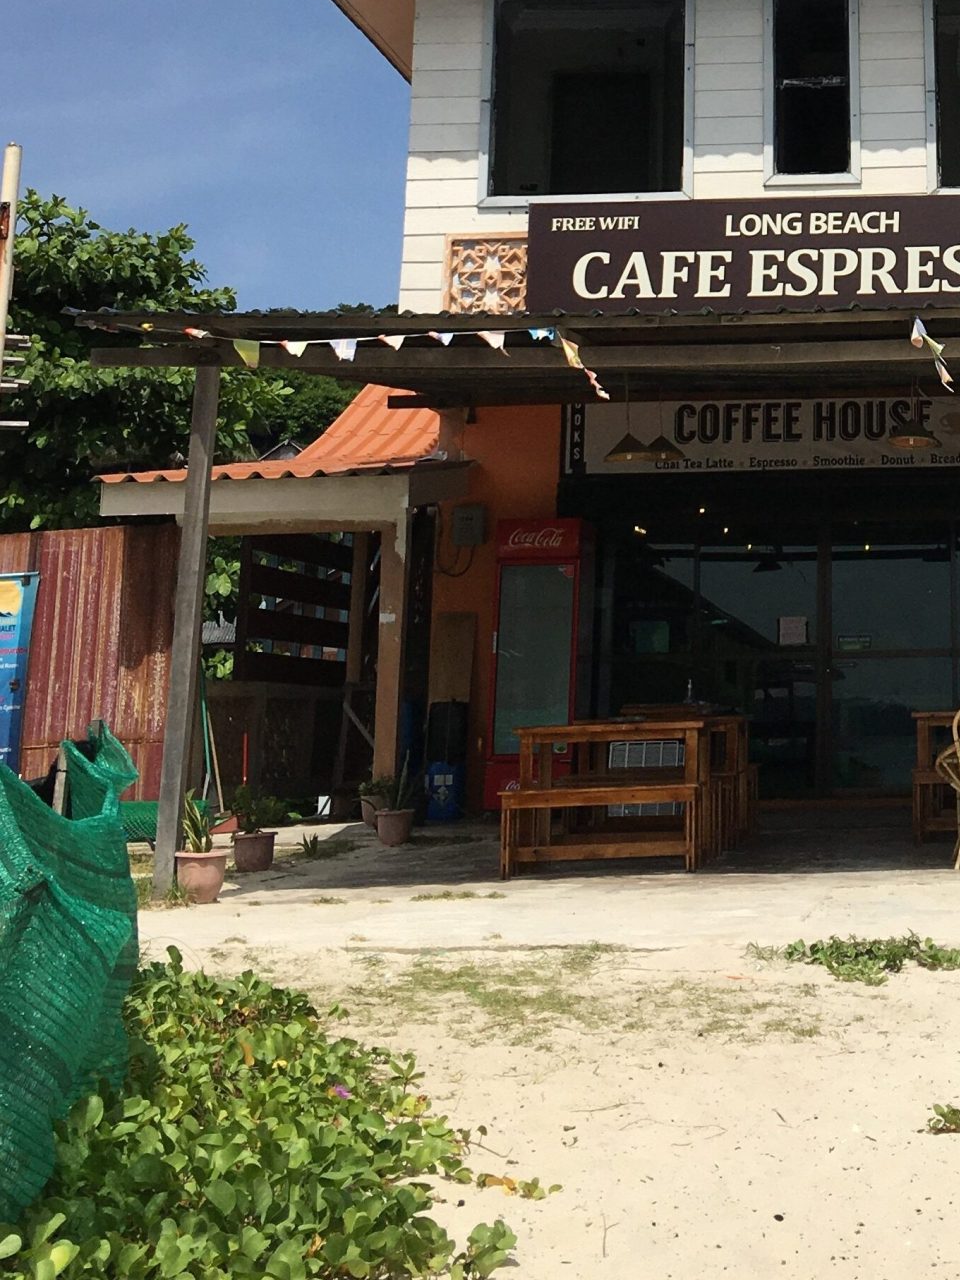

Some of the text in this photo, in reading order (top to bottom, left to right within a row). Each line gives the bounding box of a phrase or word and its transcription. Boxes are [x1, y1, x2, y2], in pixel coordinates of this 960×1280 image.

[551, 216, 640, 231] FREE WIFI
[725, 211, 900, 237] LONG BEACH
[572, 251, 733, 300] CAFE
[674, 399, 933, 444] COFFEE HOUSE
[683, 458, 702, 468] Tea
[706, 457, 734, 468] Latte
[749, 457, 798, 471] Espresso
[813, 455, 865, 467] Smoothie
[881, 455, 915, 465] Donut
